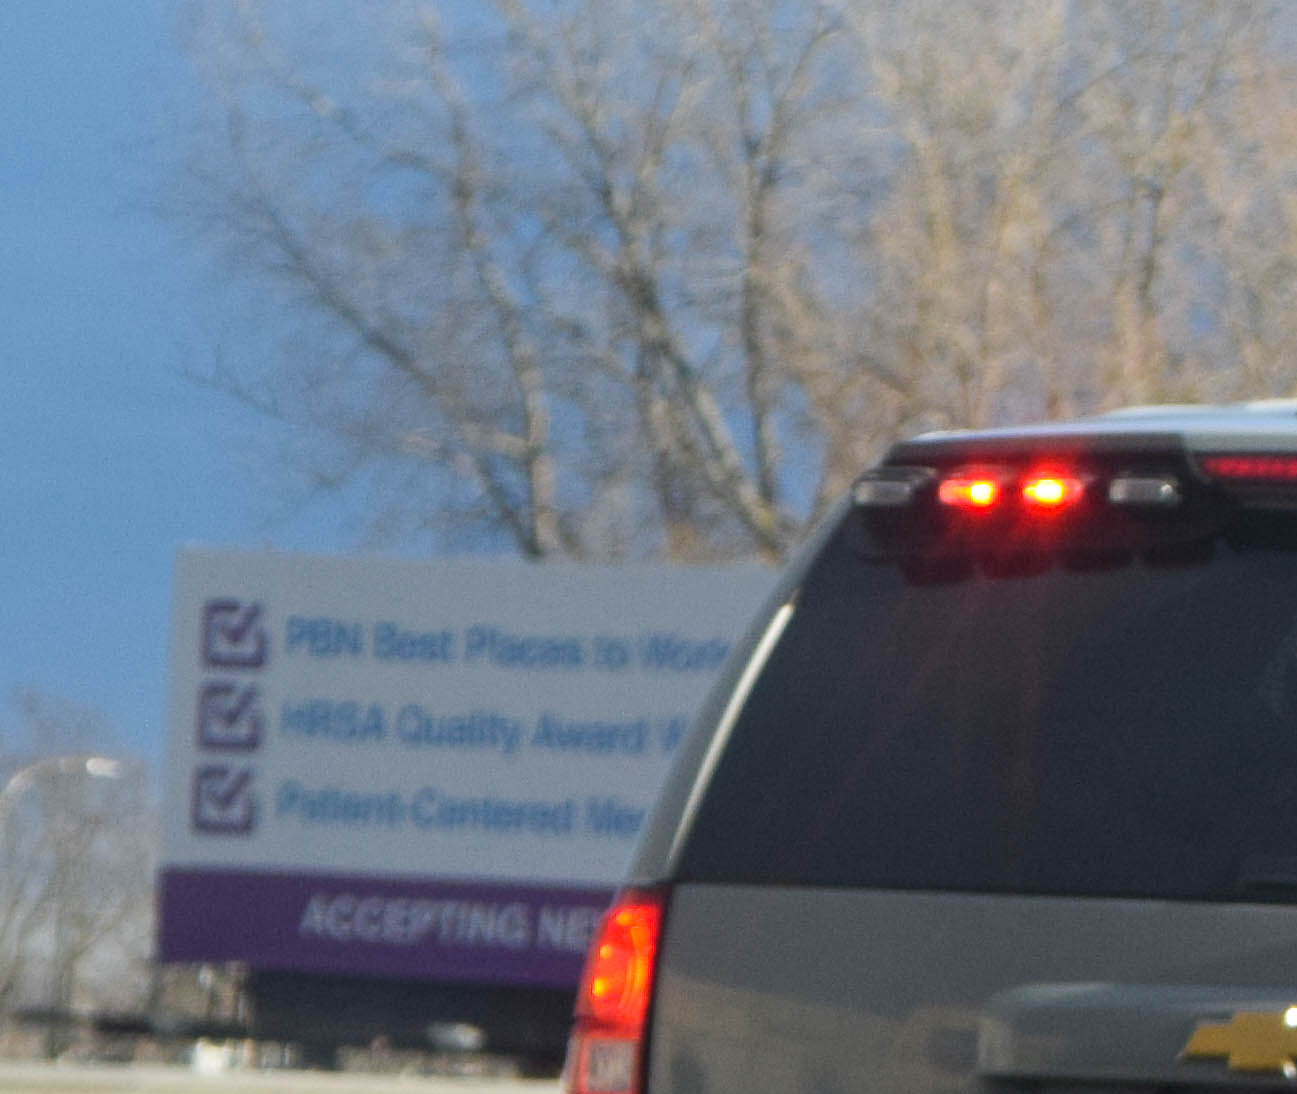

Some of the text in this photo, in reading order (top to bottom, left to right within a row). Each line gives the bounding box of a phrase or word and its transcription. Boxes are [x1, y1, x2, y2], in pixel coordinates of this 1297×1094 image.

[374, 621, 451, 661] Best
[463, 624, 582, 668] Places
[397, 704, 520, 755] Quality
[533, 712, 646, 750] Award
[299, 896, 528, 944] ACCEPTING
